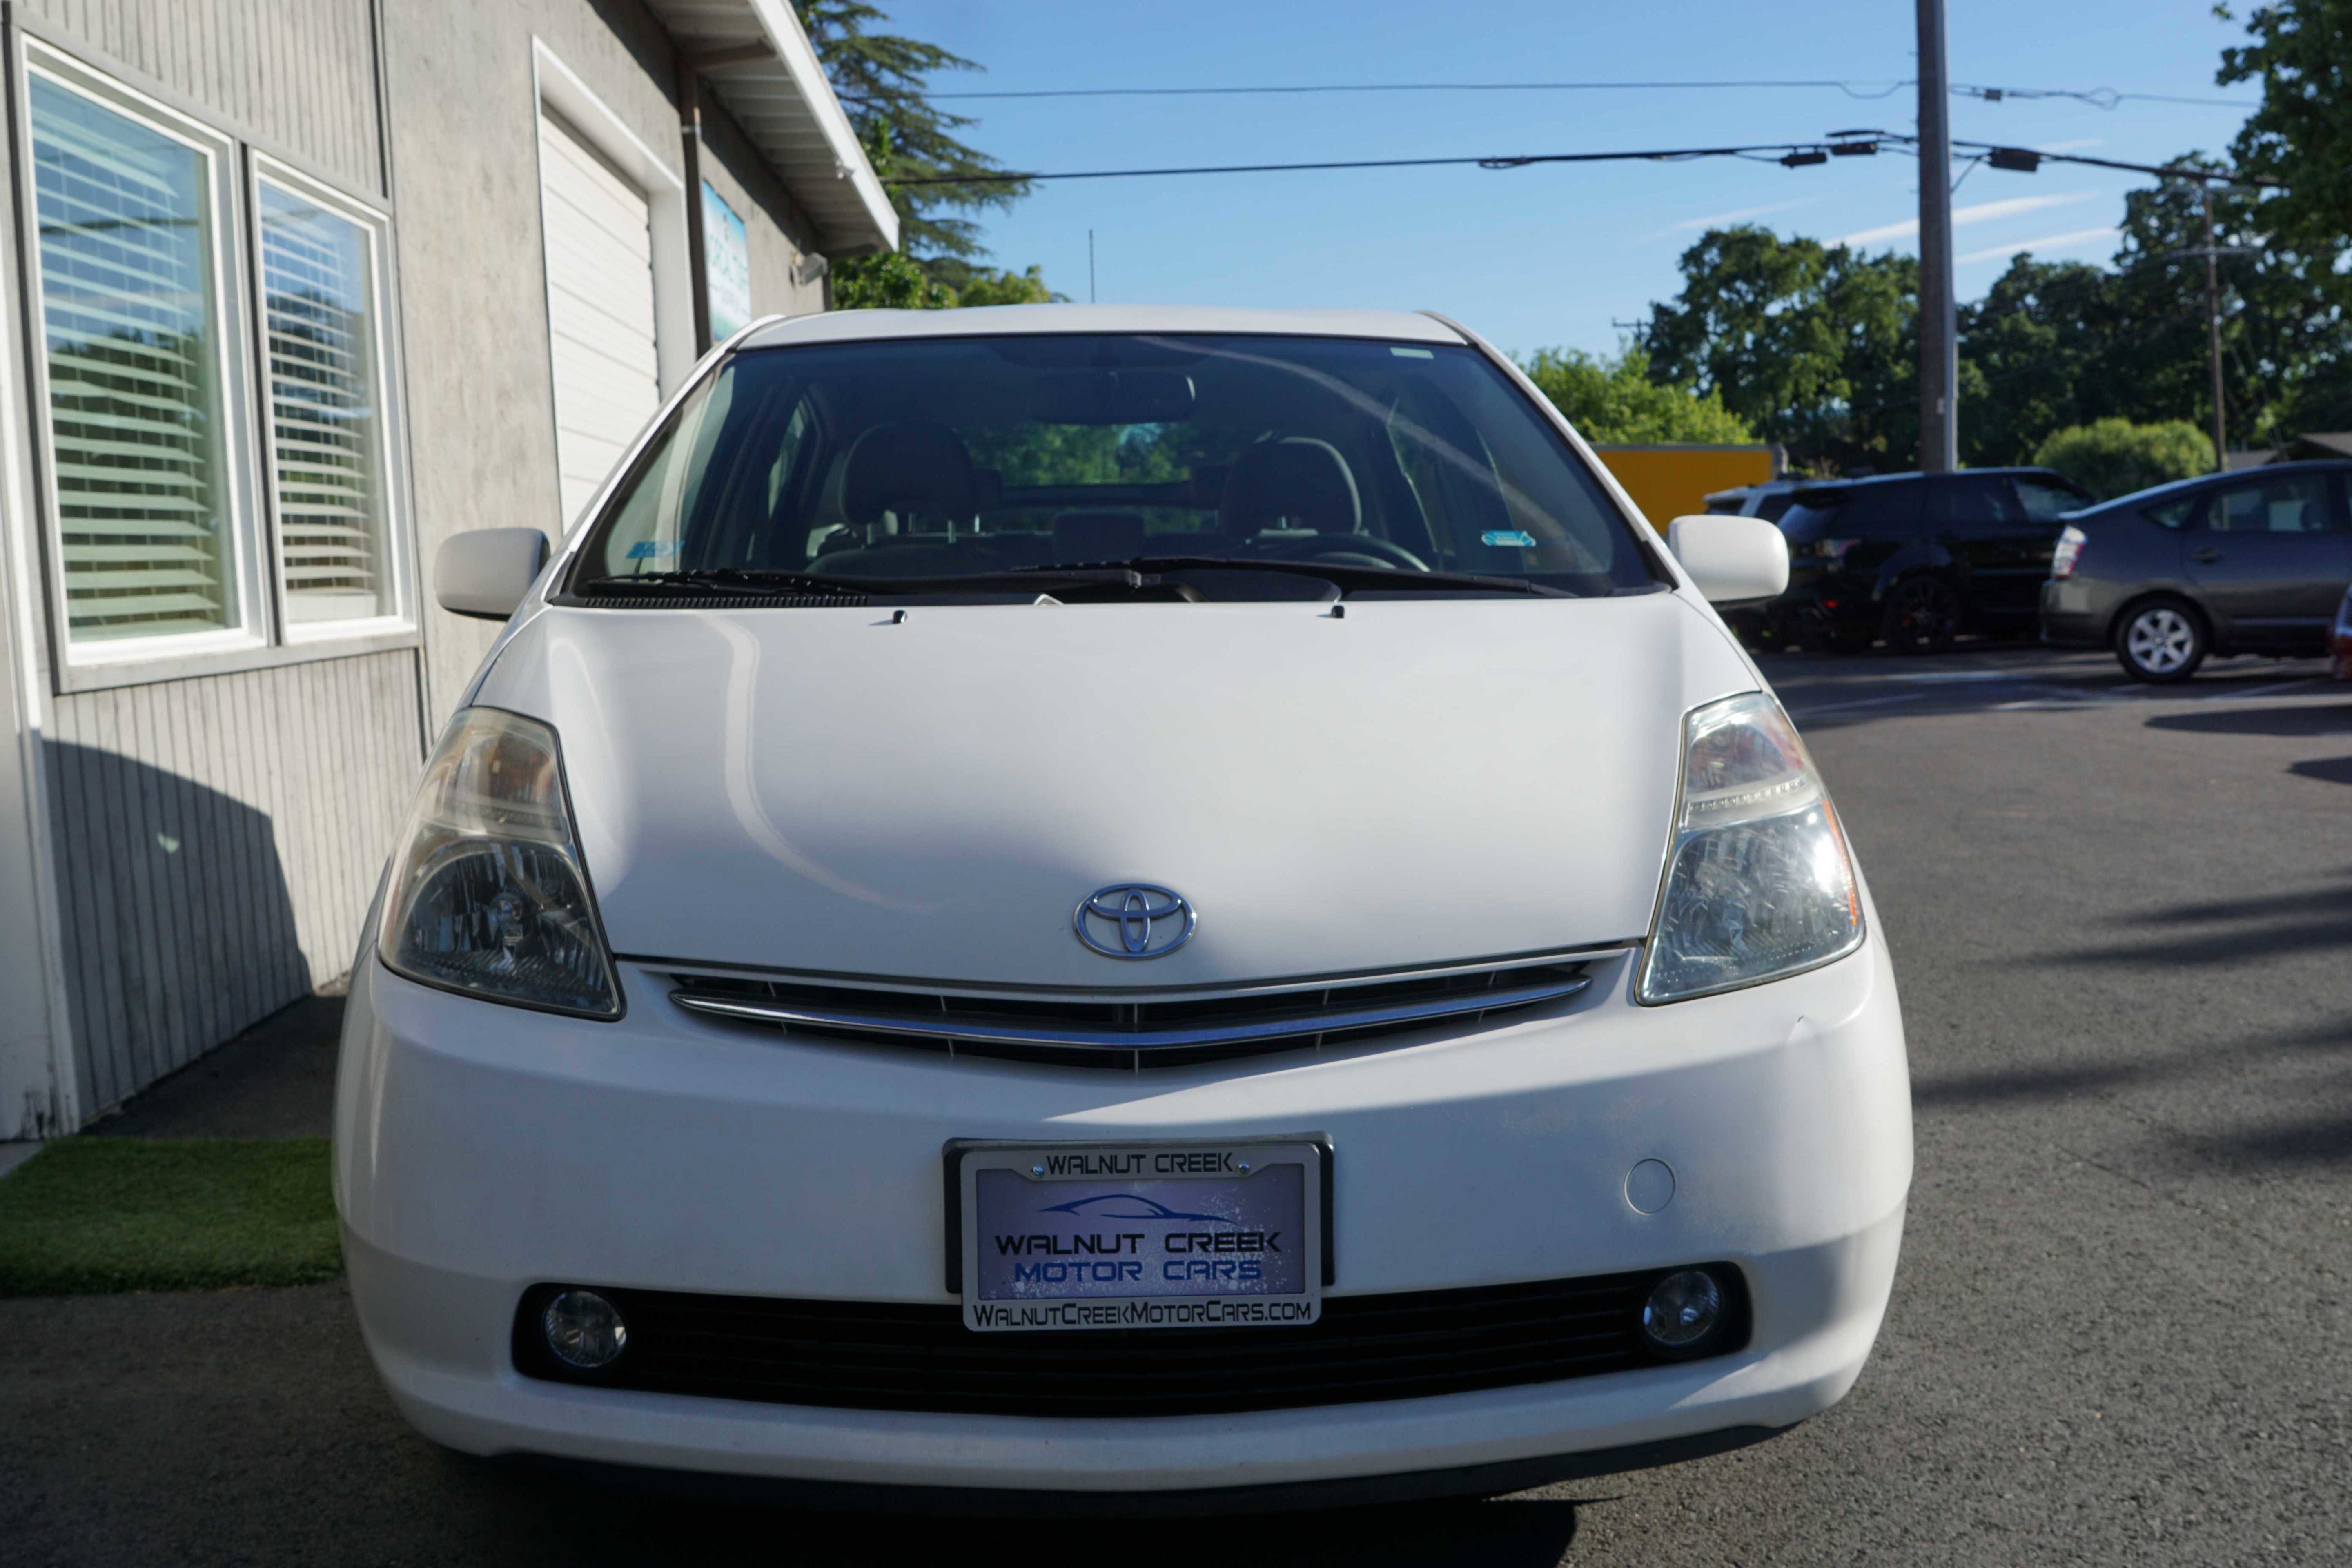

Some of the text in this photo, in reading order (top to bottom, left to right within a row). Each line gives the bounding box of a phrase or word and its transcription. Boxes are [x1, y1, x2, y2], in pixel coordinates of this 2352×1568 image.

[1046, 1152, 1232, 1175] WALNUT CREEK
[995, 1232, 1281, 1255] WALNUT CREEK
[1015, 1260, 1261, 1283] MOTOR CARS
